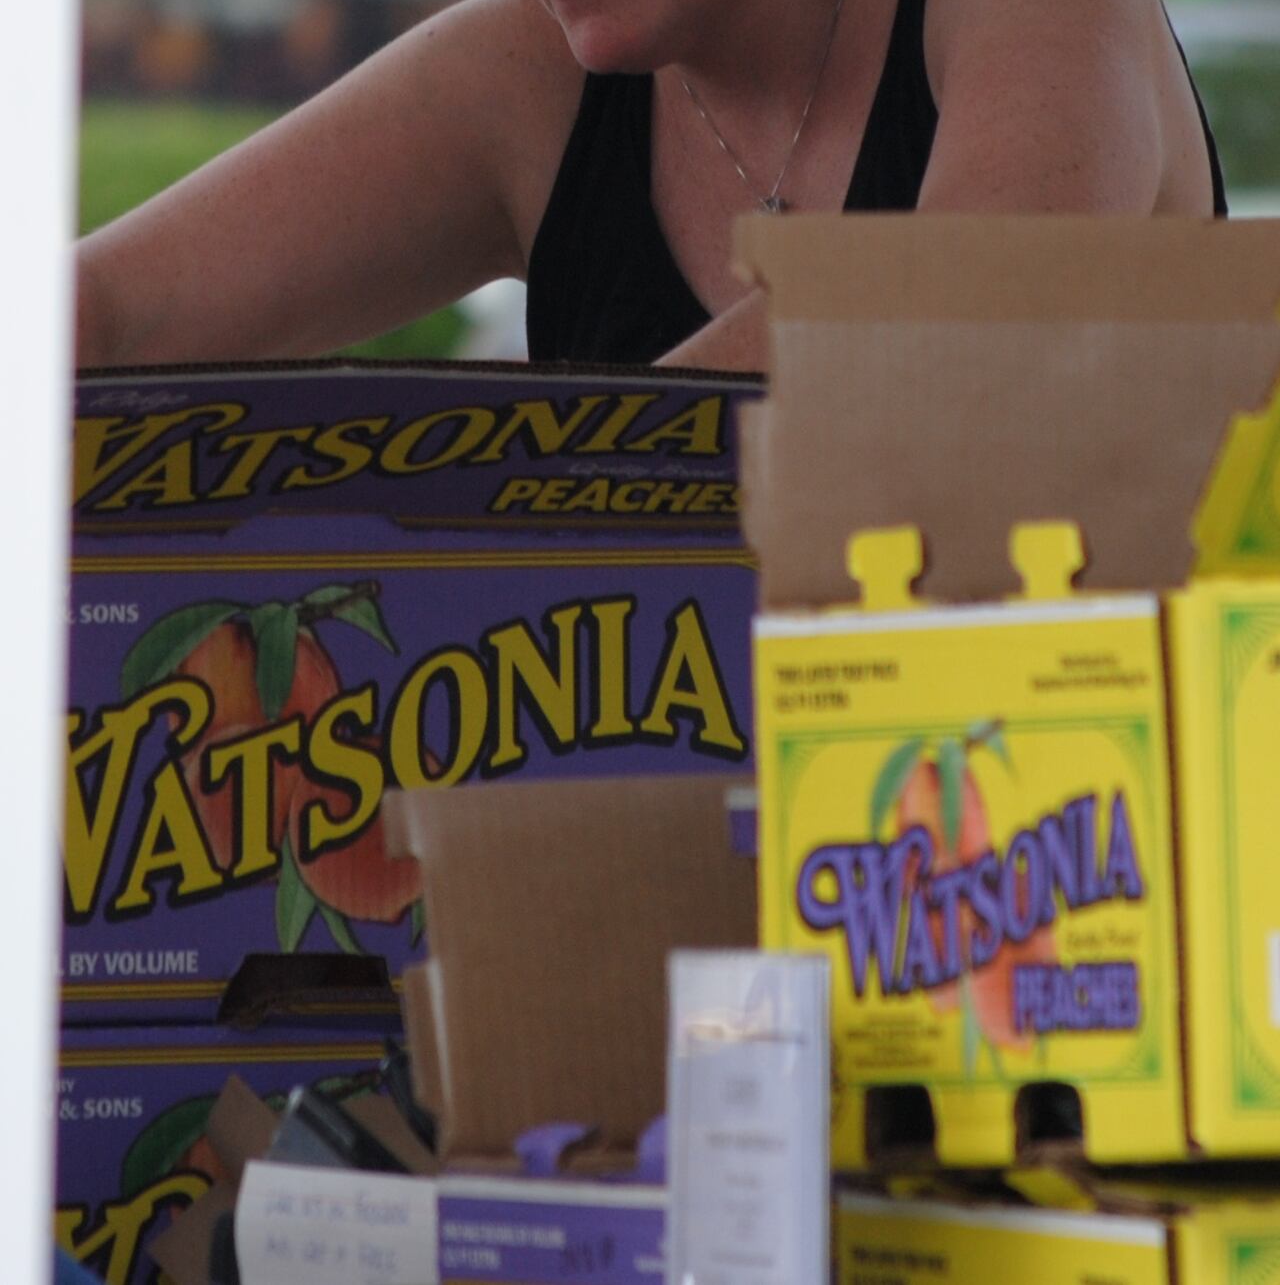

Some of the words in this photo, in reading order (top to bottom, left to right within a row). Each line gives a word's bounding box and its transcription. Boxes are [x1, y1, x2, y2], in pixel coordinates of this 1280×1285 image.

[79, 604, 139, 623] SONS
[795, 787, 1145, 998] WATSONIA
[69, 951, 99, 977] BY
[103, 947, 199, 976] VOLUME
[83, 1098, 143, 1120] SONS
